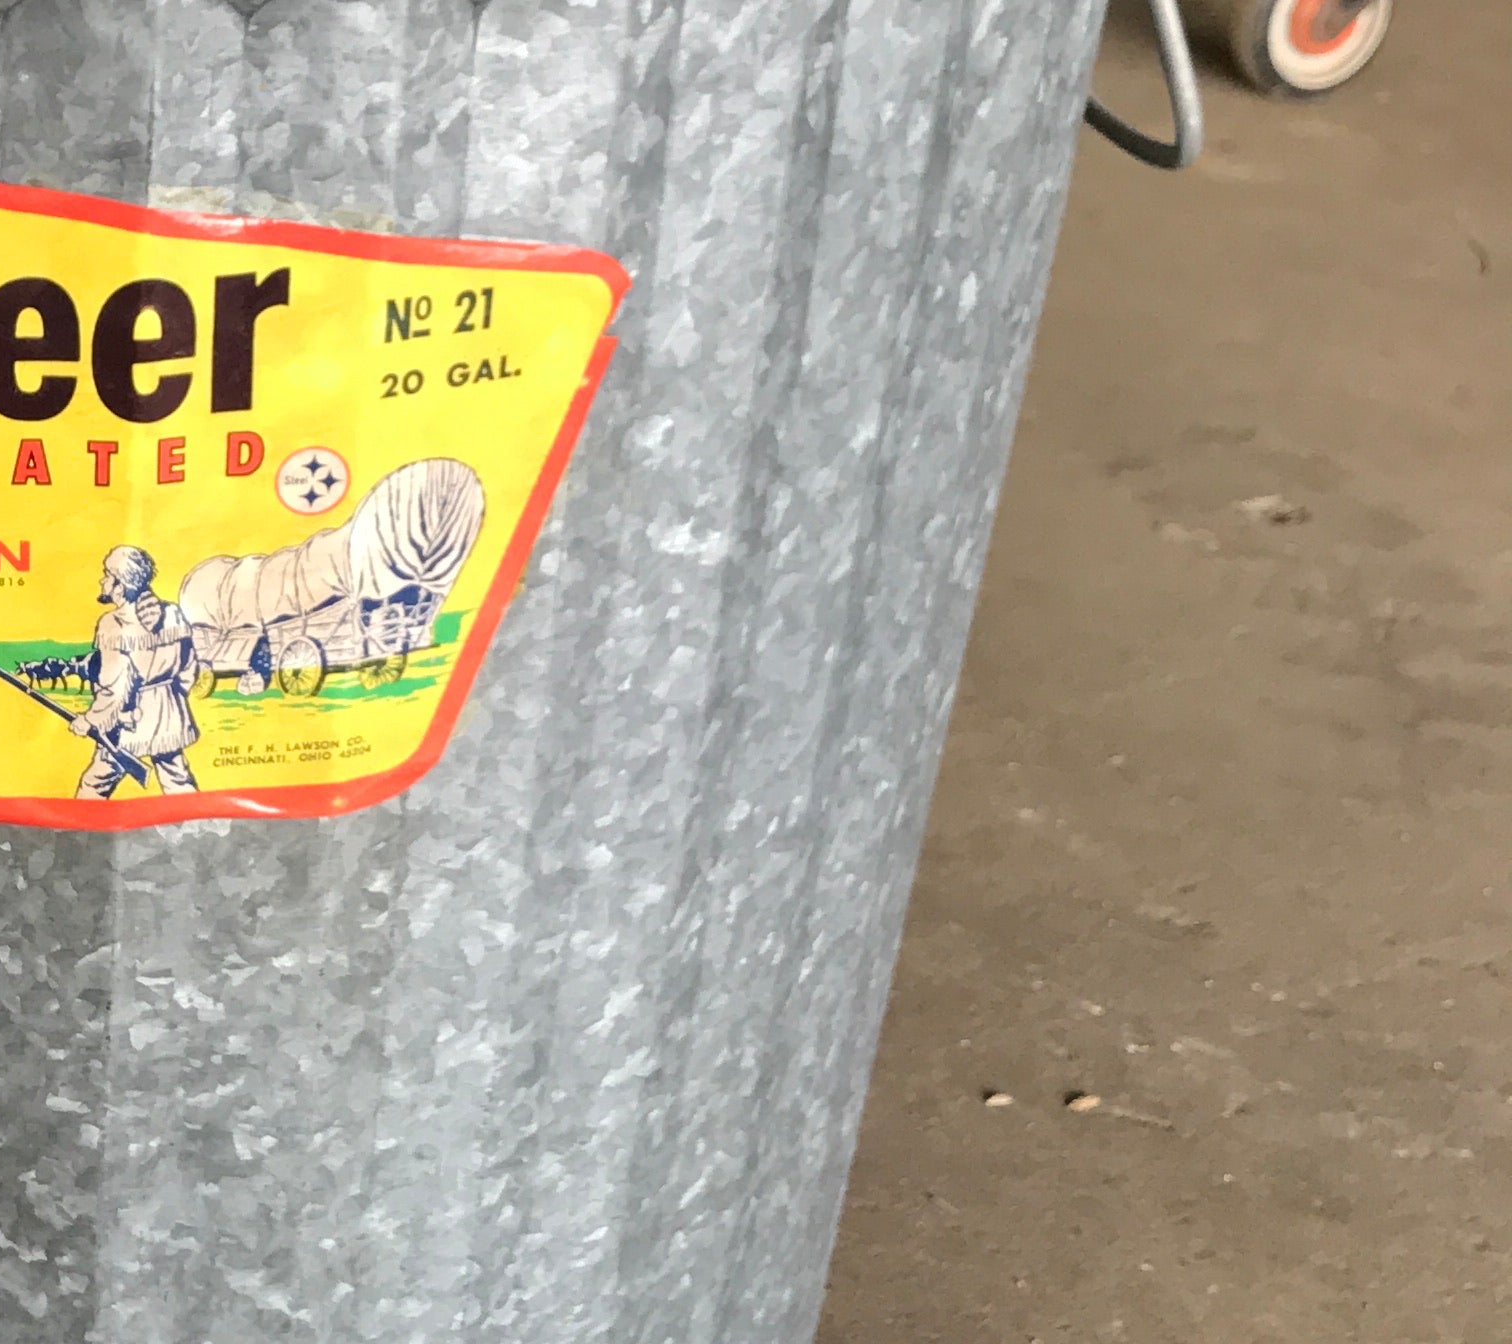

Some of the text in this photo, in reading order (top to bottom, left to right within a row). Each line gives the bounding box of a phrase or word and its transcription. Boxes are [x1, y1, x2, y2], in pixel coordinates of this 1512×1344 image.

[453, 286, 494, 334] 21
[380, 354, 522, 399] 20 GAL.
[219, 745, 240, 755] THE
[285, 740, 340, 752] LAWSON
[298, 751, 333, 763] OHIO
